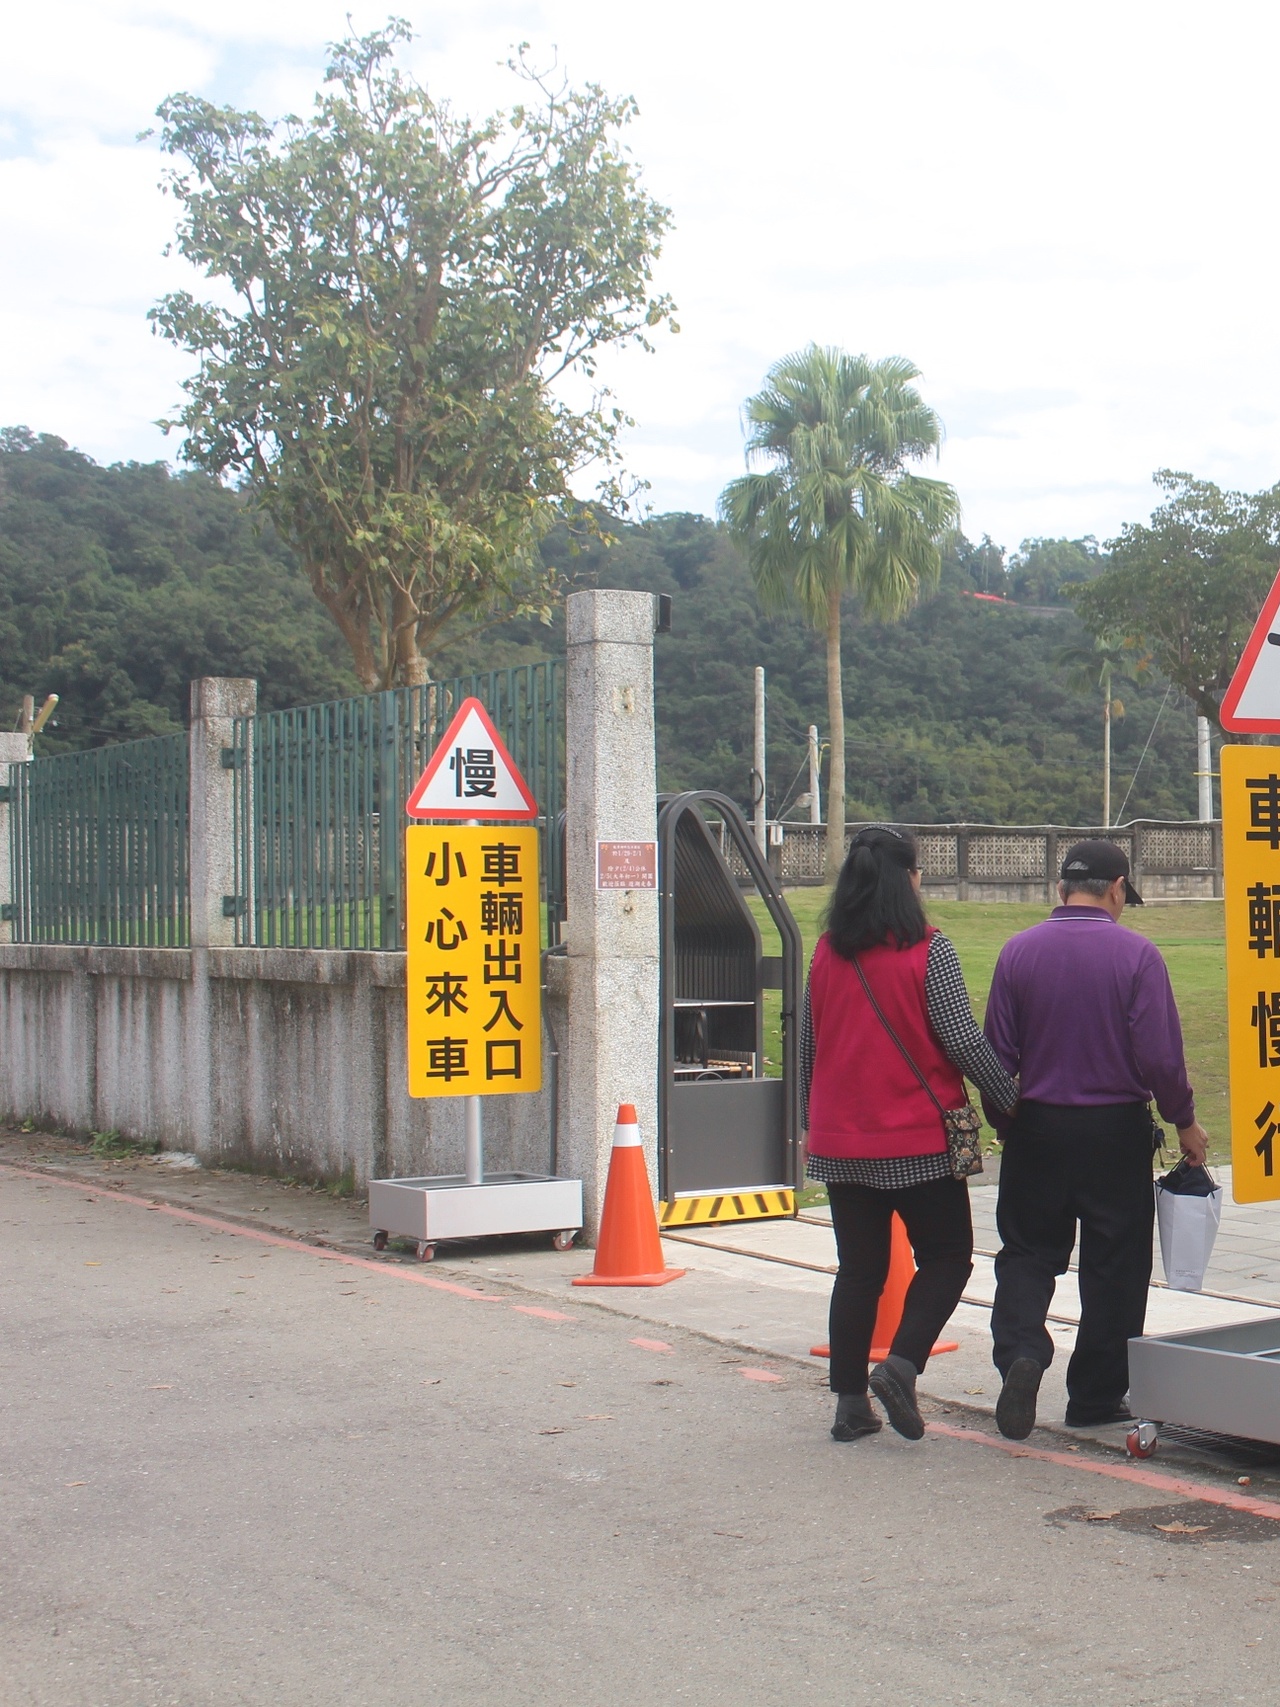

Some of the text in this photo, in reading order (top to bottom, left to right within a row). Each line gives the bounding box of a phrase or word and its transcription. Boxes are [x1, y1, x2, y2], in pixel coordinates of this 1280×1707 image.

[449, 746, 498, 798] 慢
[424, 841, 470, 1082] 小心來車
[480, 842, 524, 1080] 車輛出入口
